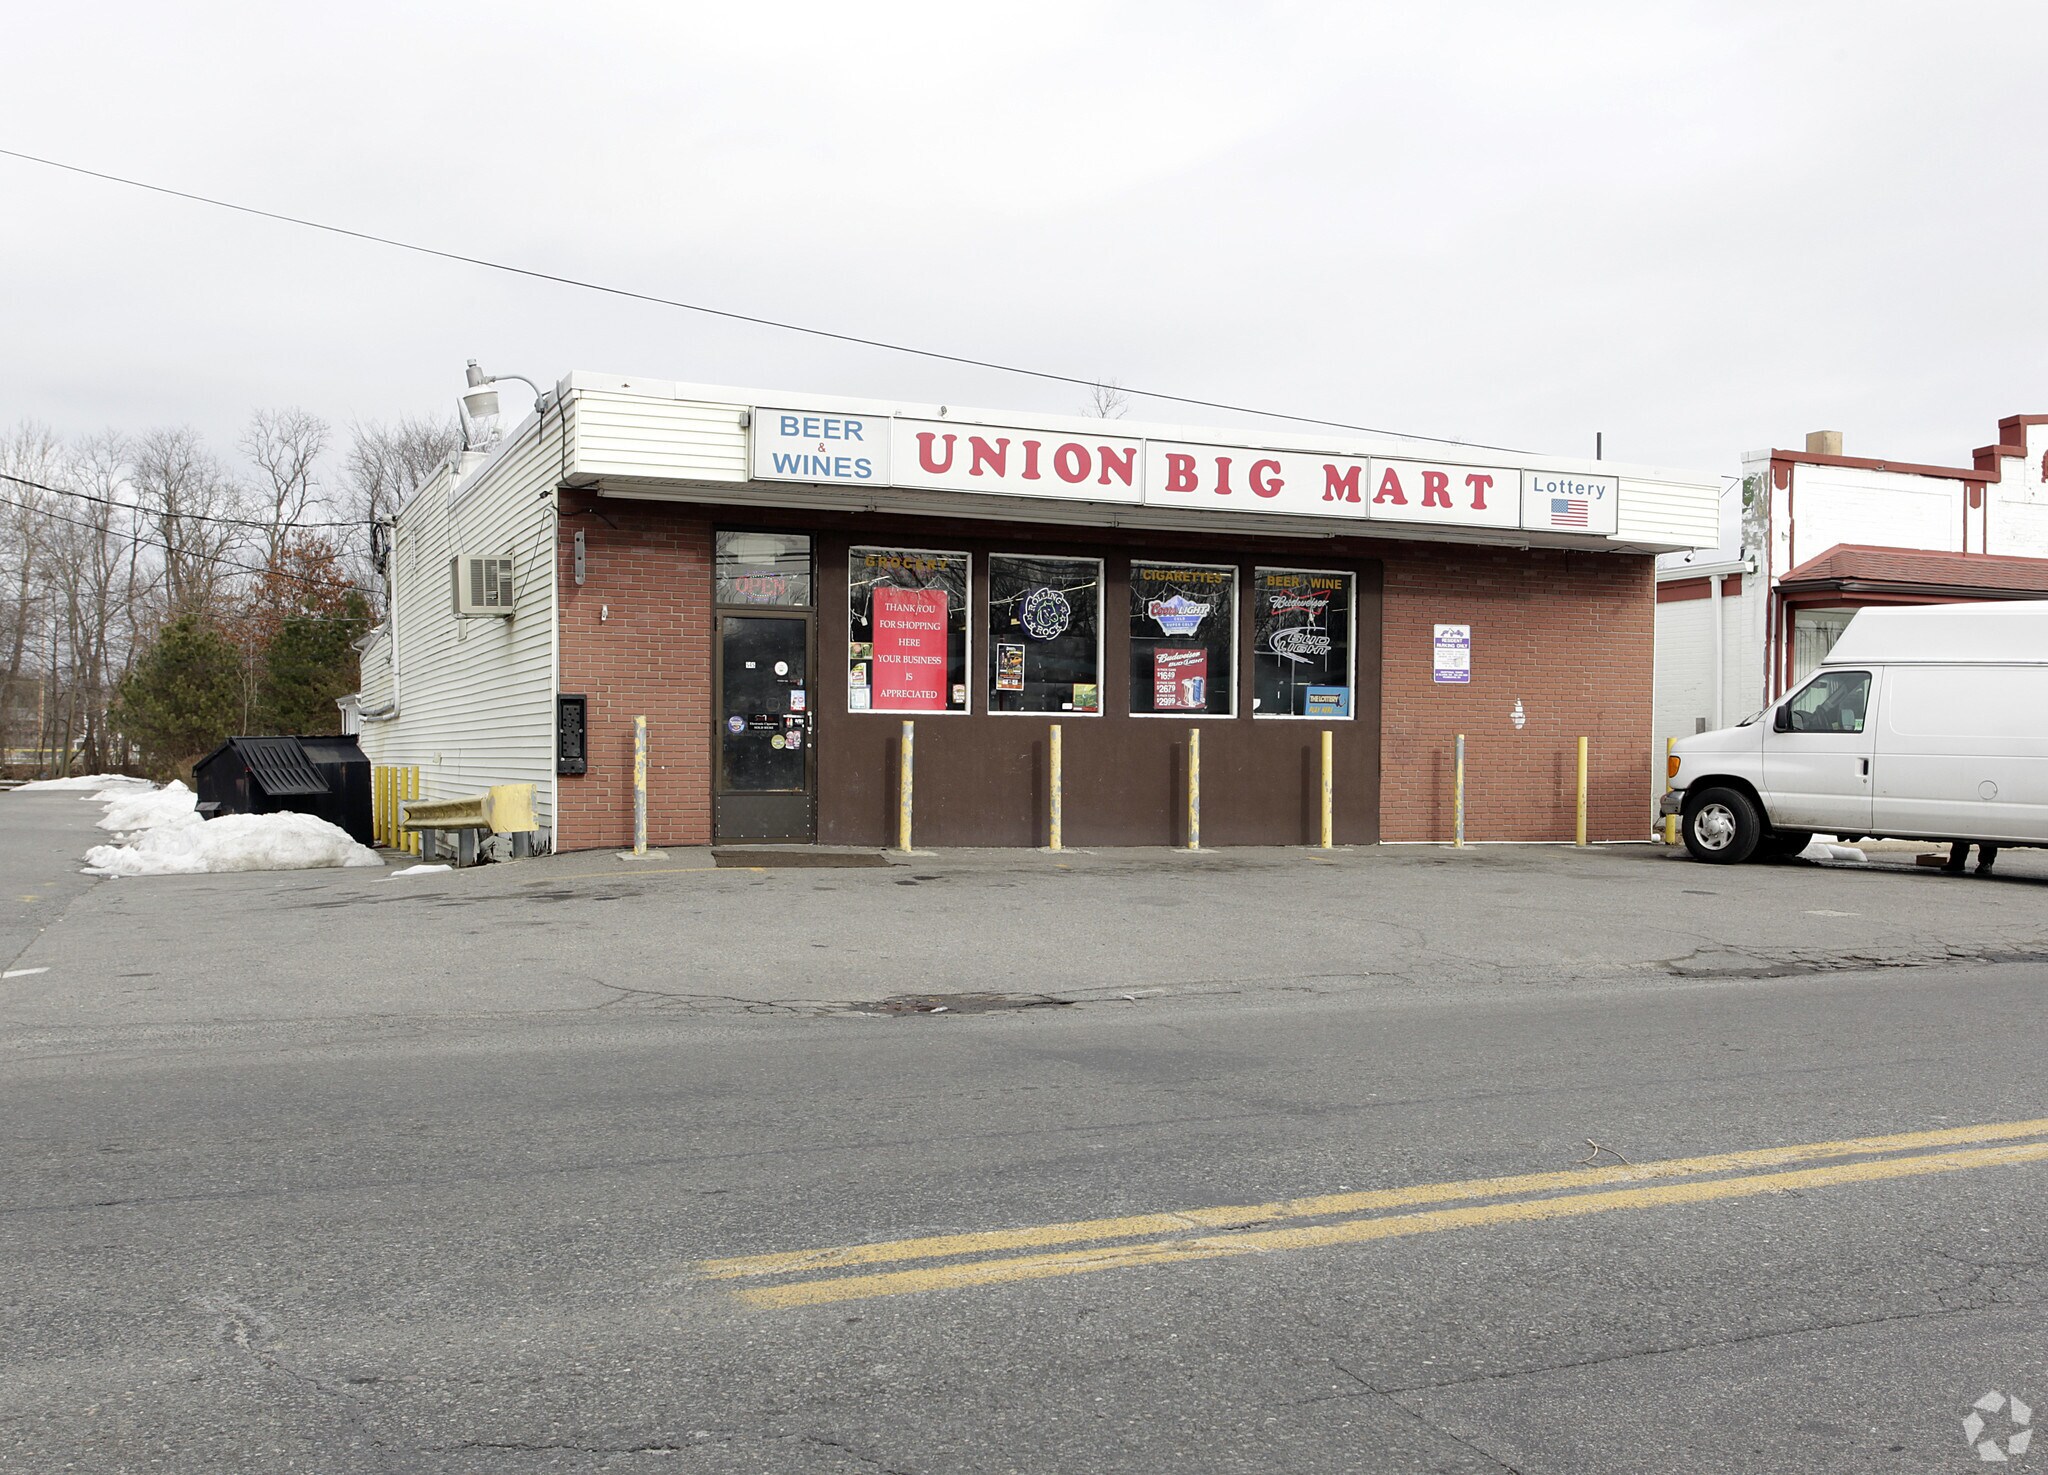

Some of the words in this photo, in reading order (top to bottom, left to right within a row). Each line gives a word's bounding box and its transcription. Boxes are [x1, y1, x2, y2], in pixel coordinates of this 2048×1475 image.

[780, 415, 864, 441] BEER
[817, 442, 826, 453] &
[772, 453, 872, 479] WINES
[916, 432, 1137, 487] UNION
[1165, 453, 1285, 499] BIG
[1322, 464, 1494, 510] MART
[1533, 477, 1606, 500] Lottery
[865, 555, 949, 571] GROCERY
[1143, 569, 1223, 583] CIGARETTES
[1267, 576, 1299, 587] BEER
[1311, 578, 1342, 590] WINE
[735, 575, 785, 596] OPEN
[885, 603, 916, 613] THANK
[918, 604, 936, 614] YOU
[1028, 592, 1063, 611] ROLLING
[1269, 595, 1330, 609] Budweiser
[1177, 605, 1208, 616] LIGHT
[880, 620, 896, 629] FOR
[897, 621, 941, 631] SHOPPING
[1036, 622, 1063, 636] ROCK
[898, 638, 921, 647] HERE
[1288, 632, 1331, 646] BUD
[1277, 641, 1332, 655] LIGHT
[878, 654, 901, 663] YOUR
[903, 655, 942, 664] BUSINESS
[1156, 650, 1201, 664] Budweiser
[905, 672, 913, 681] IS
[880, 689, 938, 699] APPRECIATED
